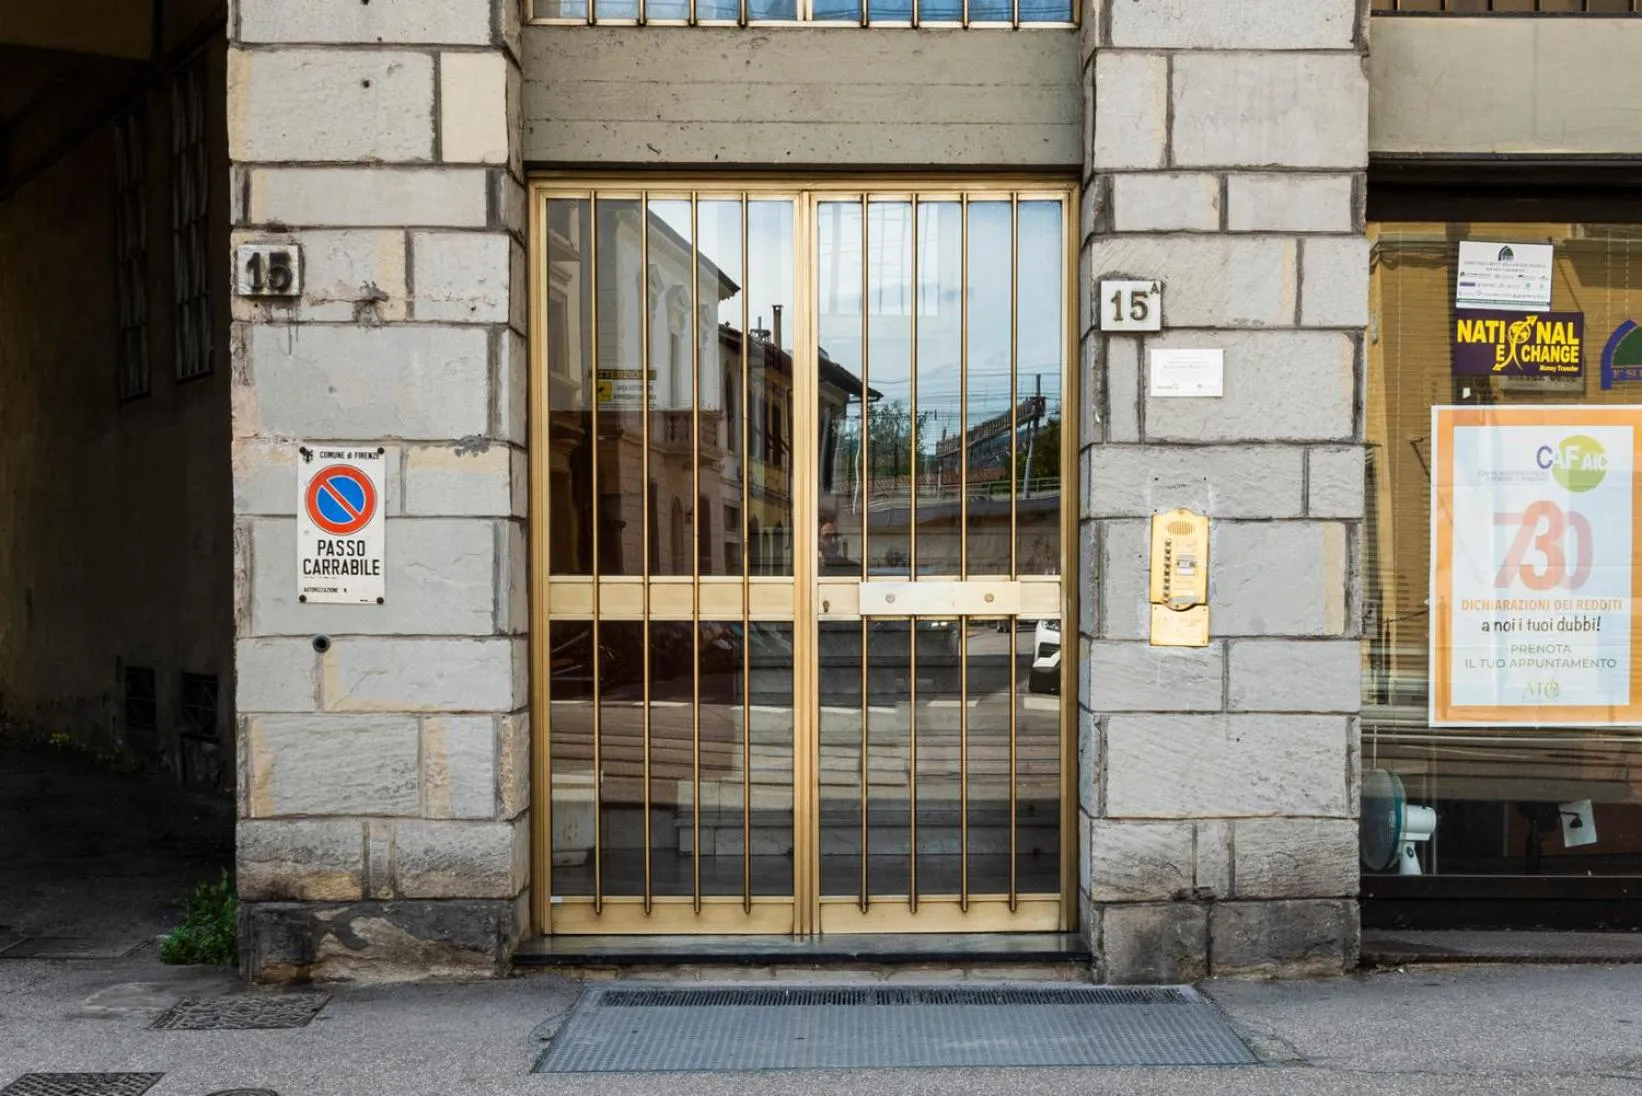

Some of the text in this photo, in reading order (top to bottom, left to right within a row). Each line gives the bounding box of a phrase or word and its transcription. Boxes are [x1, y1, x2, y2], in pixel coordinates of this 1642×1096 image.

[246, 251, 293, 290] 15
[1110, 281, 1160, 322] 15 A
[1539, 365, 1580, 373] Money Transfer
[319, 450, 345, 460] COMUNE
[354, 451, 380, 460] FIRENZE
[317, 539, 366, 557] PASSO
[1493, 500, 1594, 591] 730
[302, 558, 381, 576] CARRABILE
[1461, 599, 1622, 612] DICHIARAZIONI DEI REDDITI
[1481, 621, 1490, 632] a
[1494, 618, 1516, 632] noi
[1527, 618, 1553, 632] tuoi
[1556, 616, 1601, 632] dubbi!
[1511, 644, 1571, 654] PRENOTA
[1465, 659, 1617, 669] IL TUO APPUNTAMENTO
